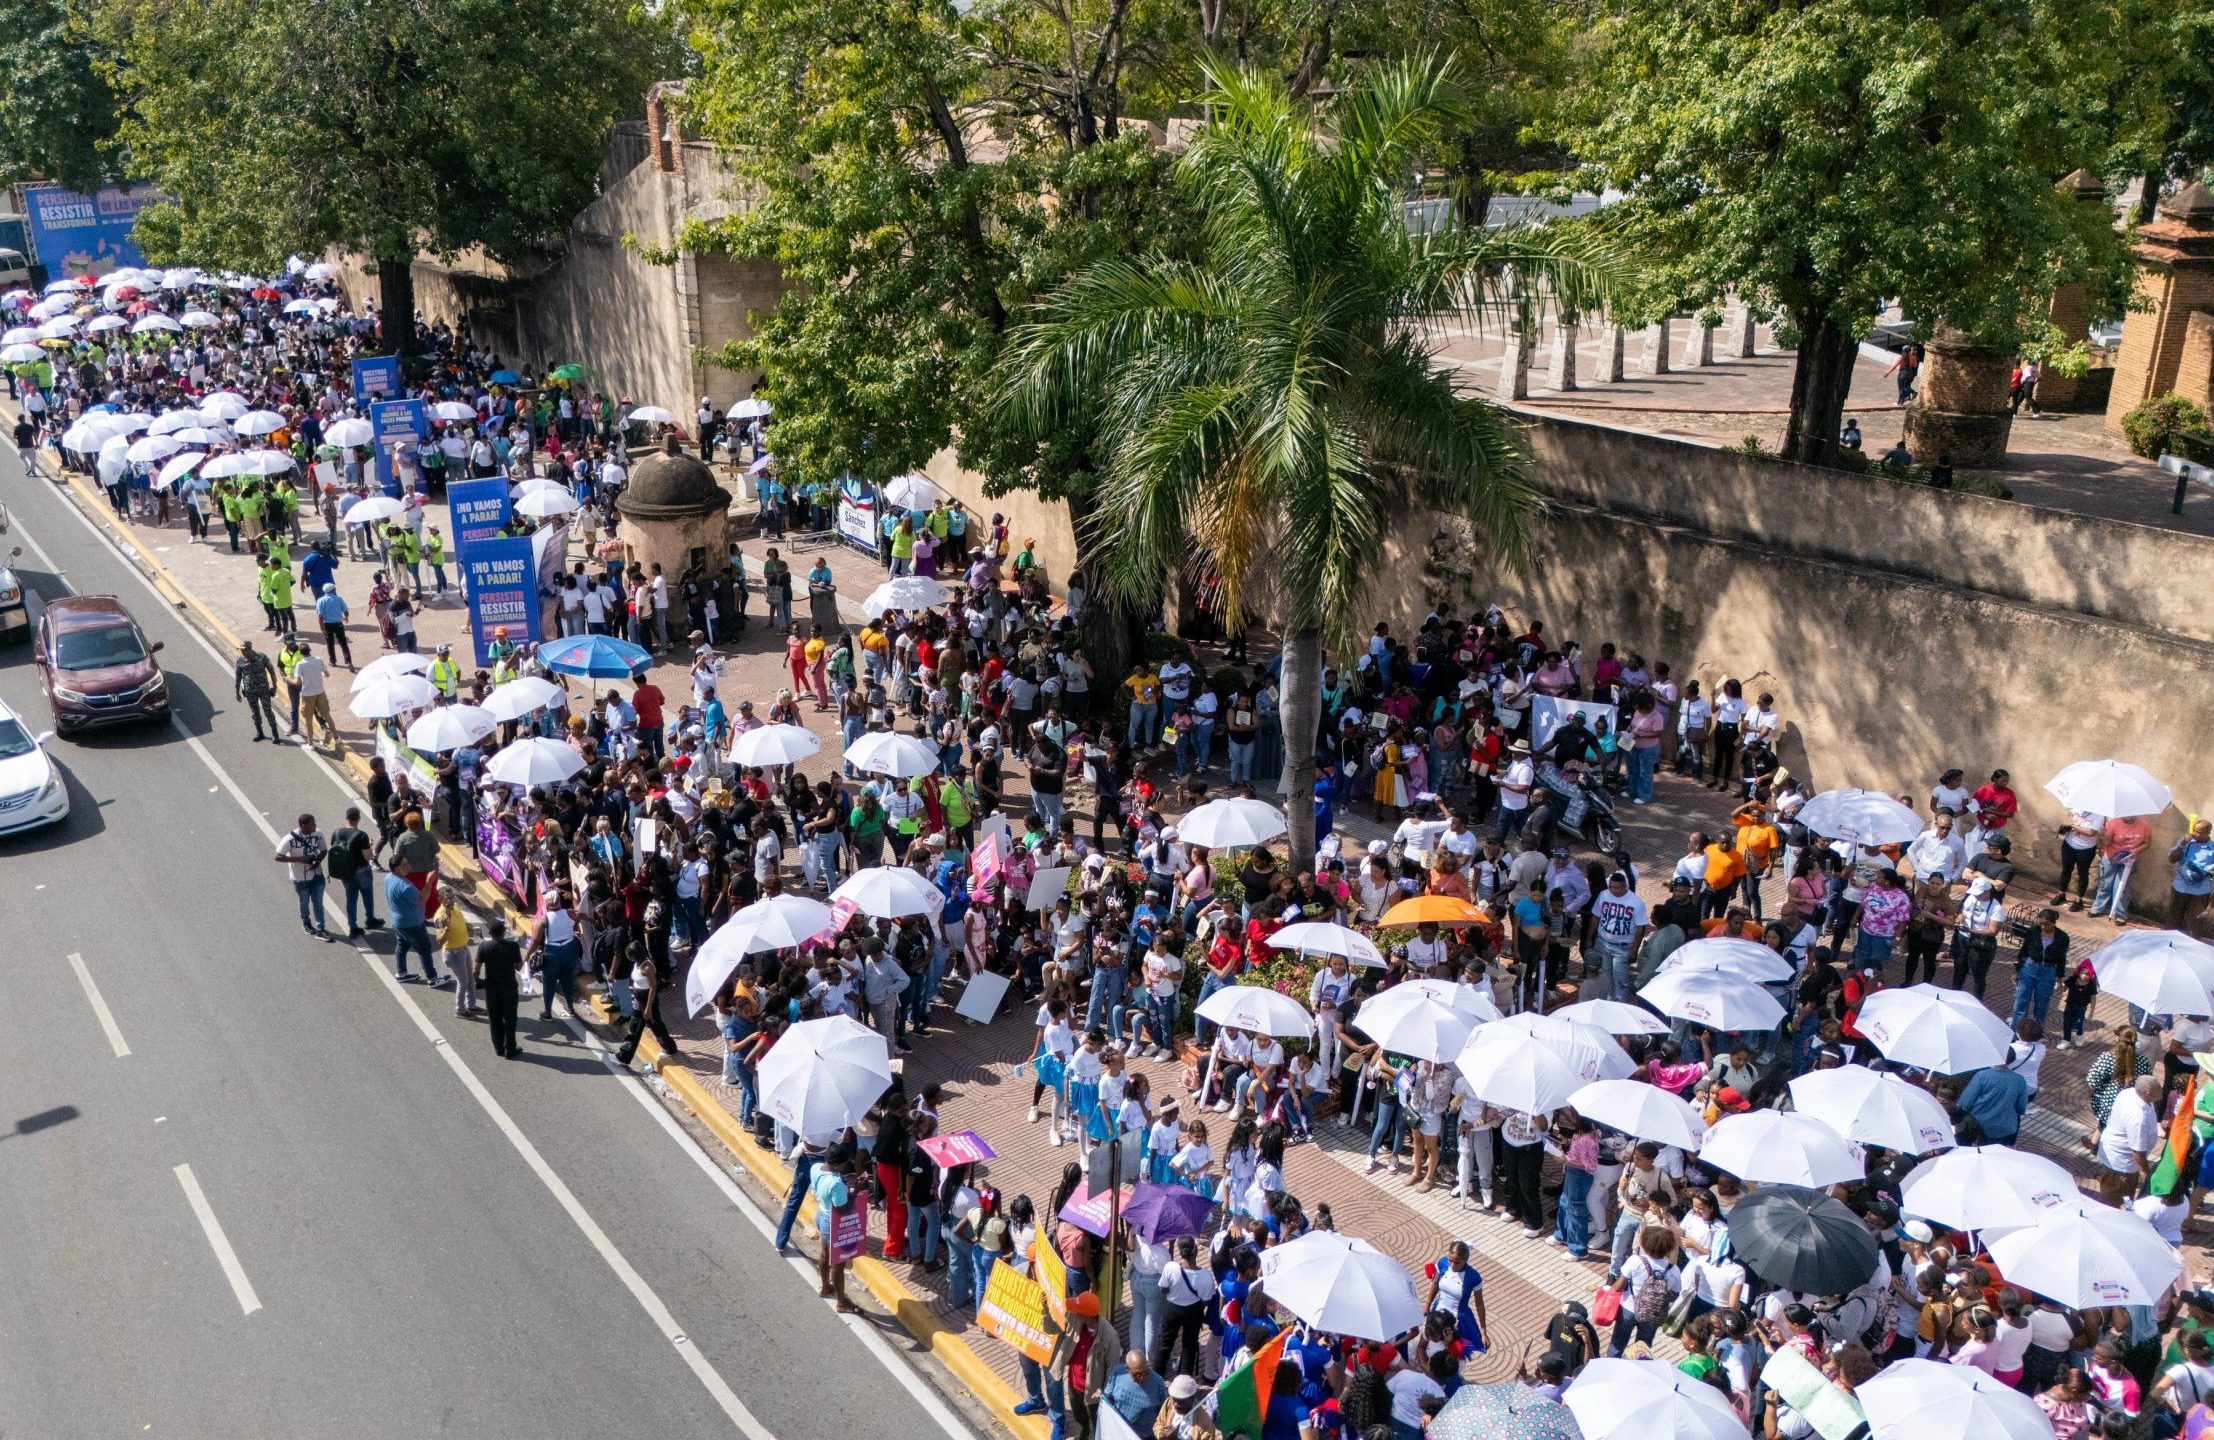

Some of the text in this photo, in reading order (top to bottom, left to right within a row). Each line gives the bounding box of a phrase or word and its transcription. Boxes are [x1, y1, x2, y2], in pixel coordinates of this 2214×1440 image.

[40, 203, 95, 221] RESISTIR
[42, 218, 97, 230] TRANSFORMAR
[456, 498, 503, 514] ¡NO VAMOS
[461, 510, 500, 524] A PARAR!
[471, 559, 525, 575] ¡NO VAMOS
[477, 572, 522, 586] A PARAR!
[479, 591, 525, 604] PERSISTIR
[479, 601, 526, 616] RESISTIR
[481, 613, 527, 623] TRANSFORMAR
[991, 1261, 1028, 1298] REAJUSTE
